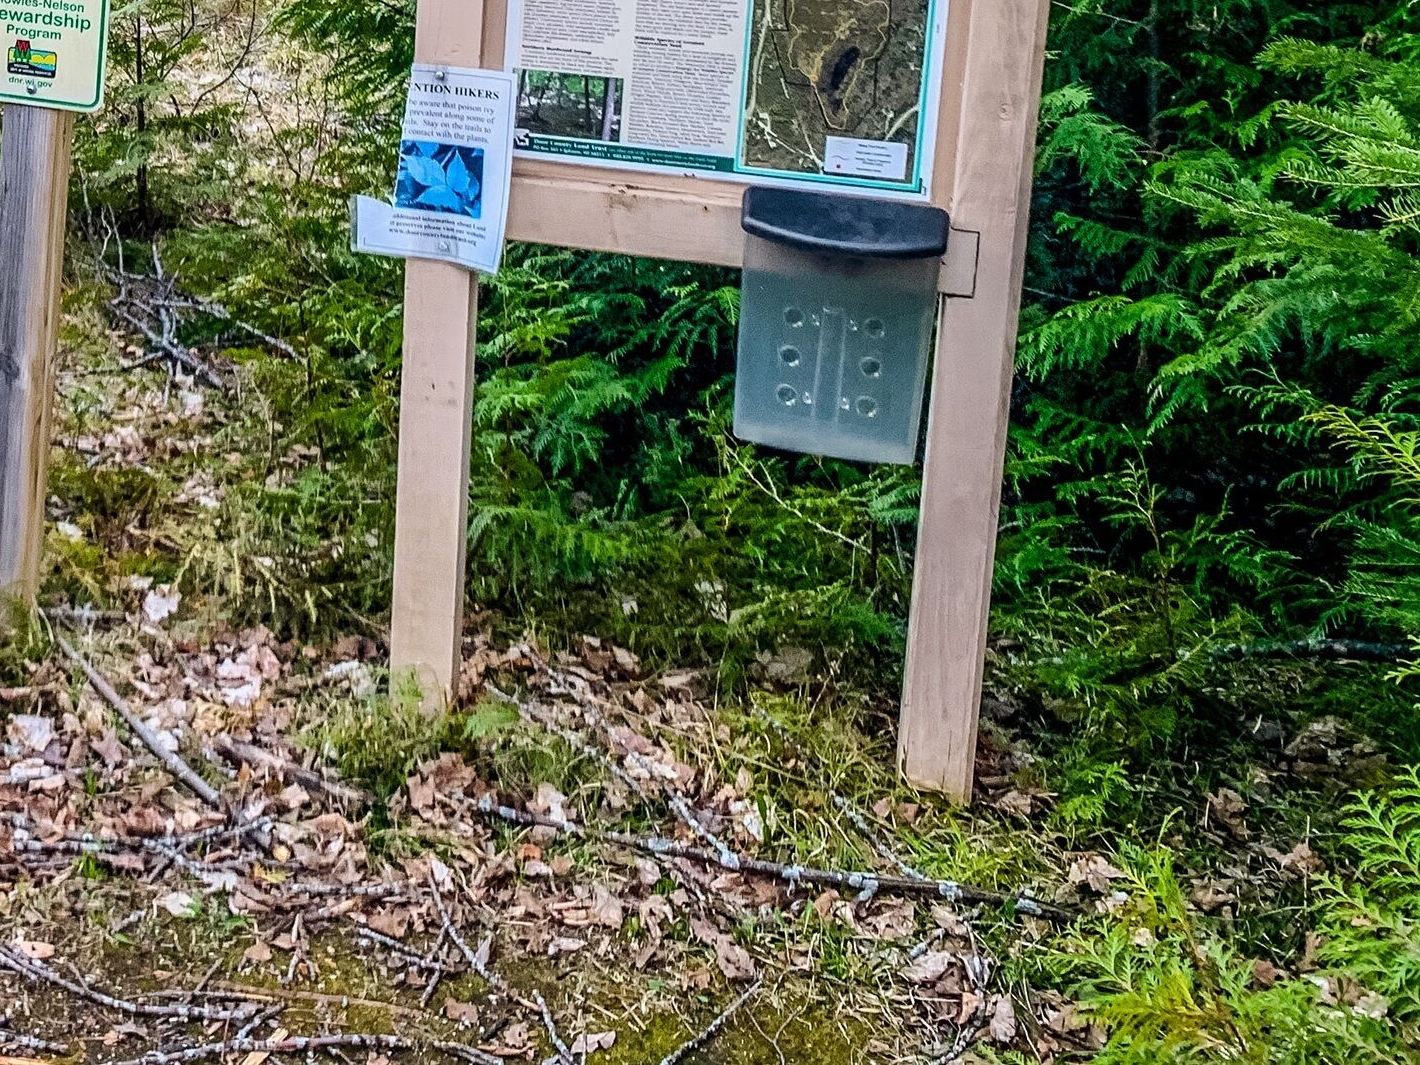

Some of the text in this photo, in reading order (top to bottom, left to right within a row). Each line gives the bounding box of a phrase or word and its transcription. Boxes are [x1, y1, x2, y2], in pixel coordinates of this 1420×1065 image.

[6, 24, 61, 40] Program
[9, 76, 53, 88] dnr.wi.gov
[455, 86, 500, 100] HIKERS
[419, 100, 441, 108] aware
[442, 100, 457, 109] that
[457, 103, 482, 112] poison
[483, 105, 494, 114] ivy
[409, 108, 495, 124] prevalent along some of
[422, 119, 439, 129] Stay
[451, 122, 464, 131] the
[464, 123, 483, 132] trails
[483, 126, 492, 134] to
[408, 128, 434, 137] contact
[435, 129, 453, 138] with
[453, 130, 465, 140] the
